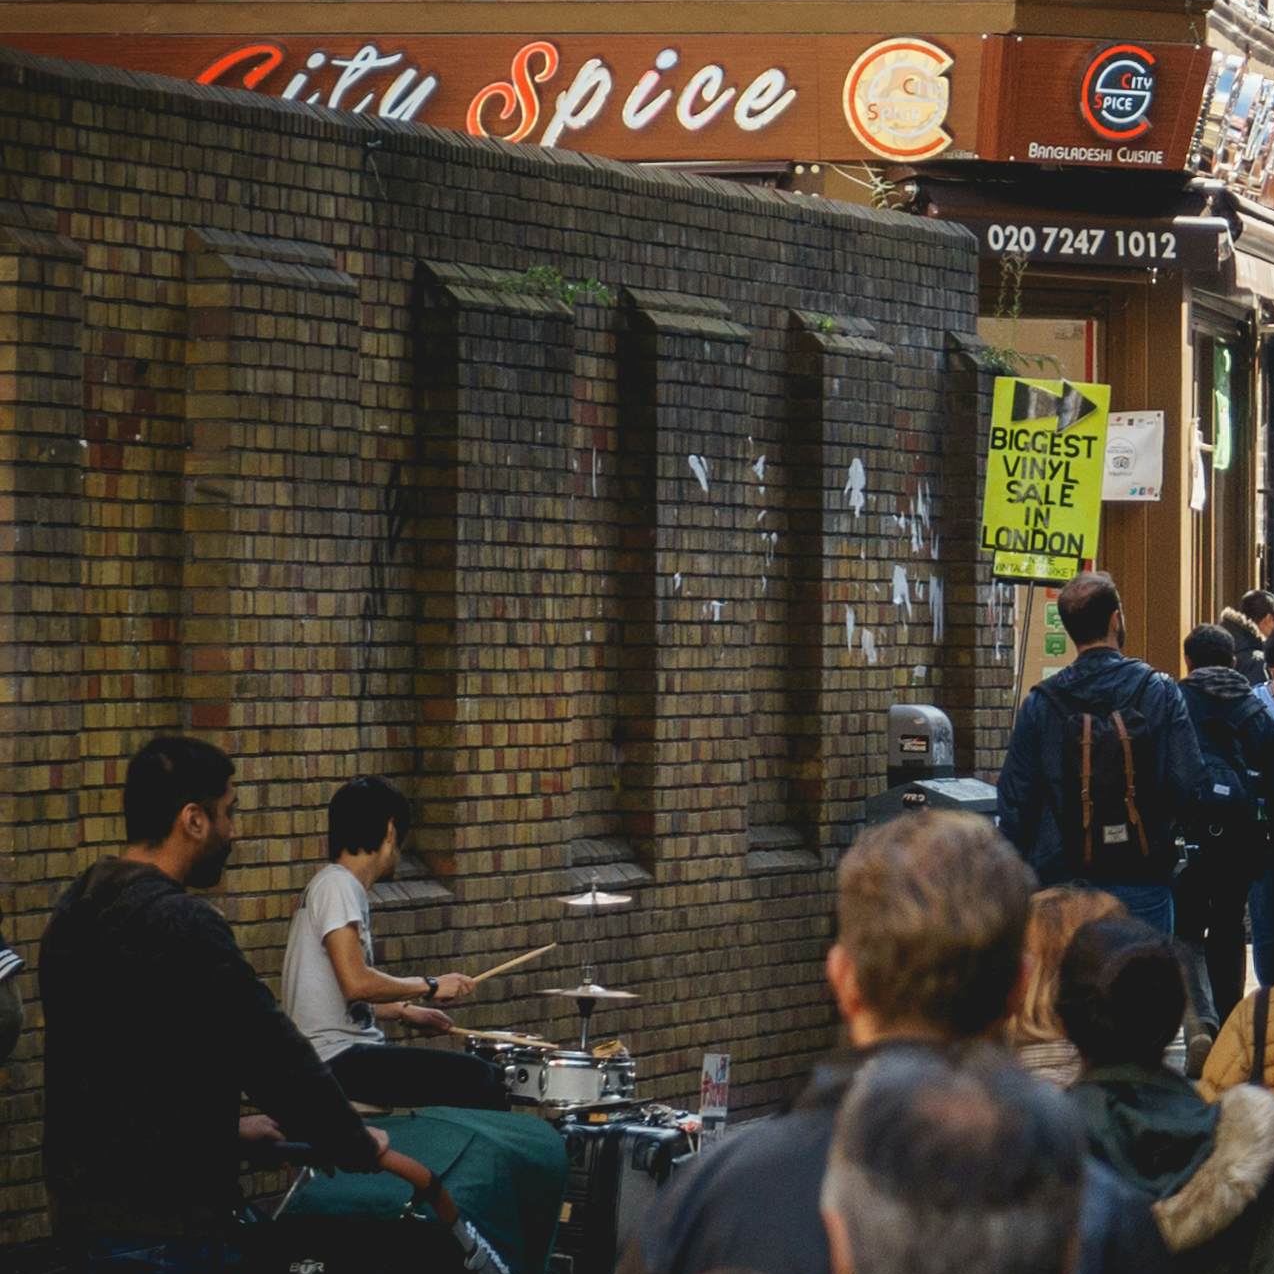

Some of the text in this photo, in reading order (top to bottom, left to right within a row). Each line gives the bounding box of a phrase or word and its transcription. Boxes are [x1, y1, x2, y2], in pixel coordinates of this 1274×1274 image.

[466, 41, 798, 148] Spice
[988, 225, 1177, 258] 020 7247 1012
[990, 427, 1098, 459] BIGGEST
[1003, 455, 1079, 484] VINYL
[1006, 480, 1075, 508] SALE
[1025, 506, 1050, 529] IN
[981, 526, 1084, 555] LONDON
